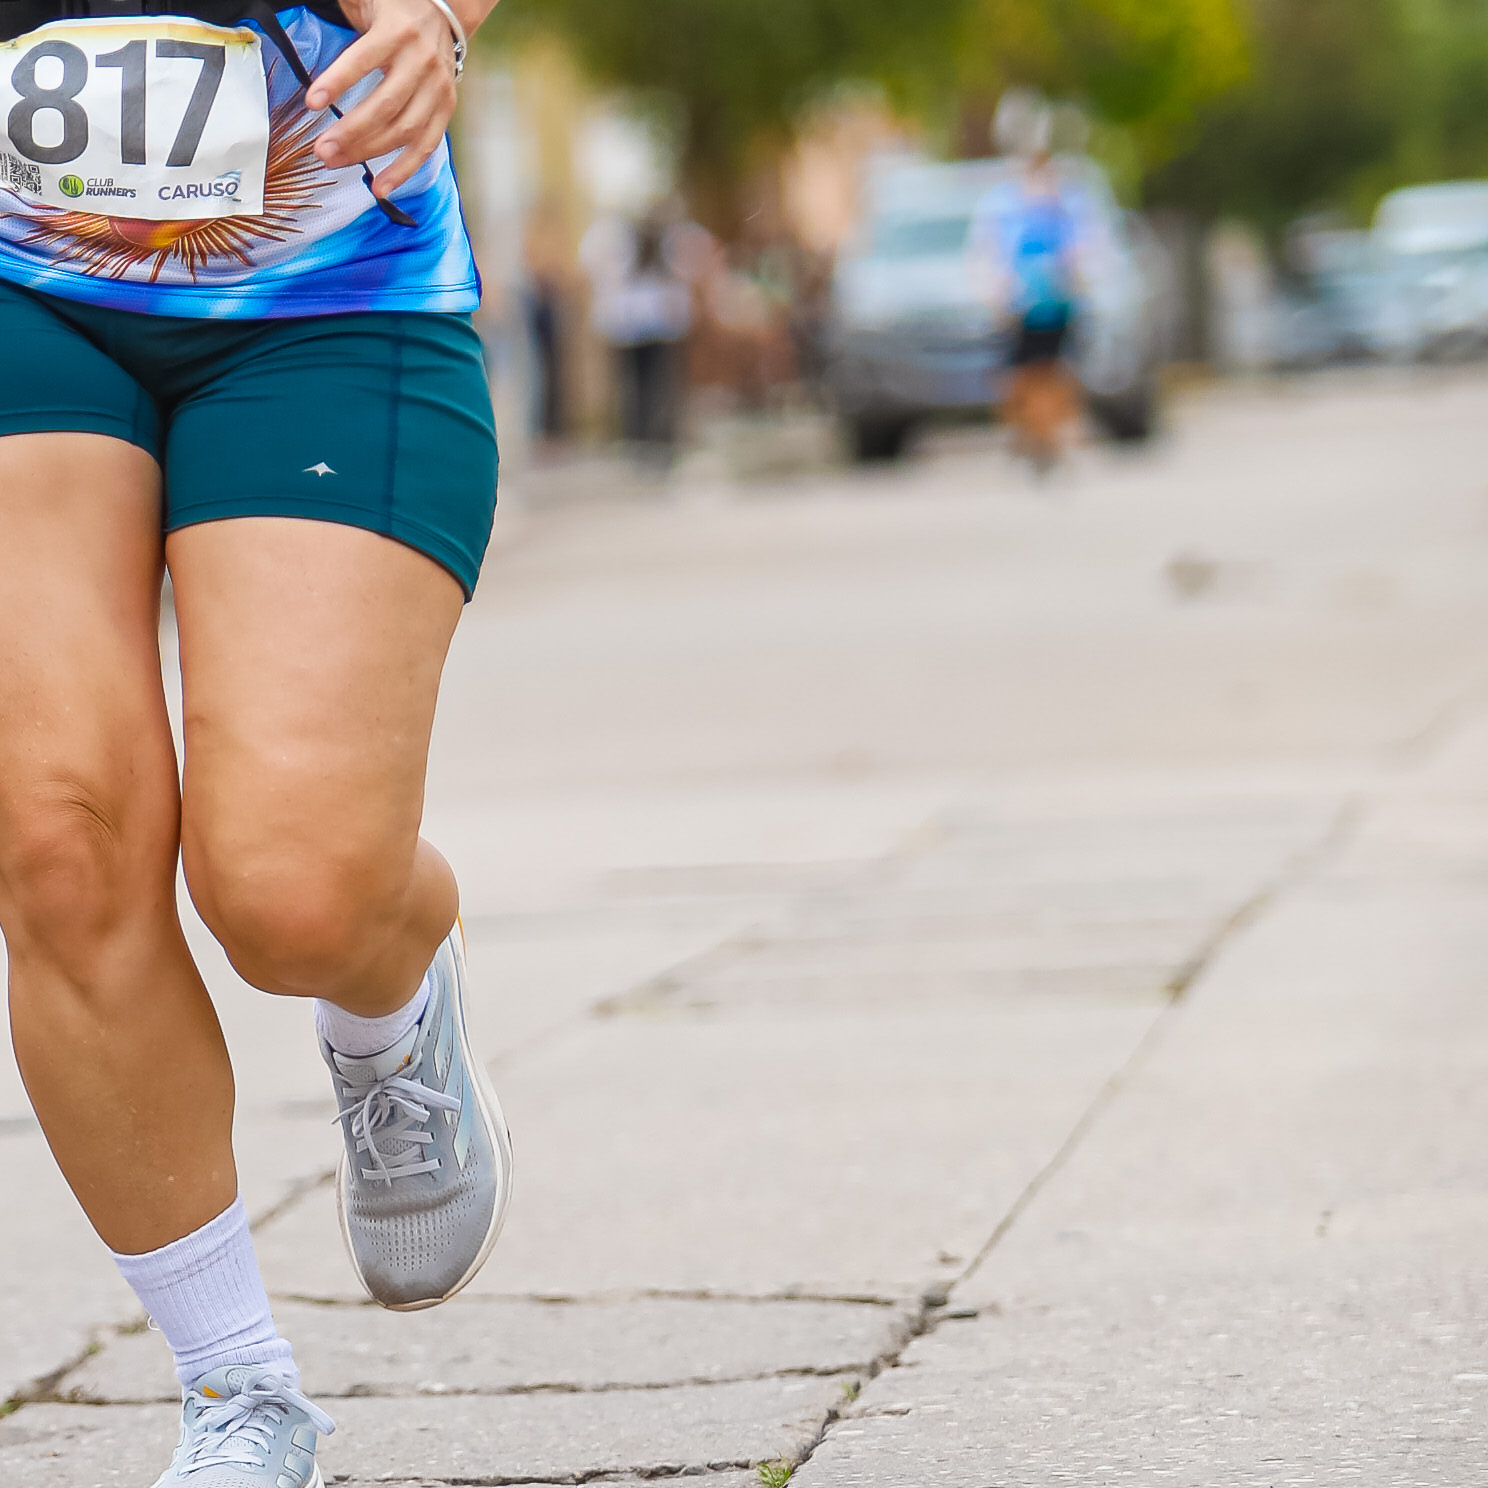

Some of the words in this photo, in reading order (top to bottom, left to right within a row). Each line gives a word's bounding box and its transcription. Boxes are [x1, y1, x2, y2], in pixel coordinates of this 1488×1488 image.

[7, 39, 226, 167] 817
[86, 177, 114, 187] CLUB
[85, 187, 137, 199] RUNNER'S
[158, 181, 239, 201] CARUSO
